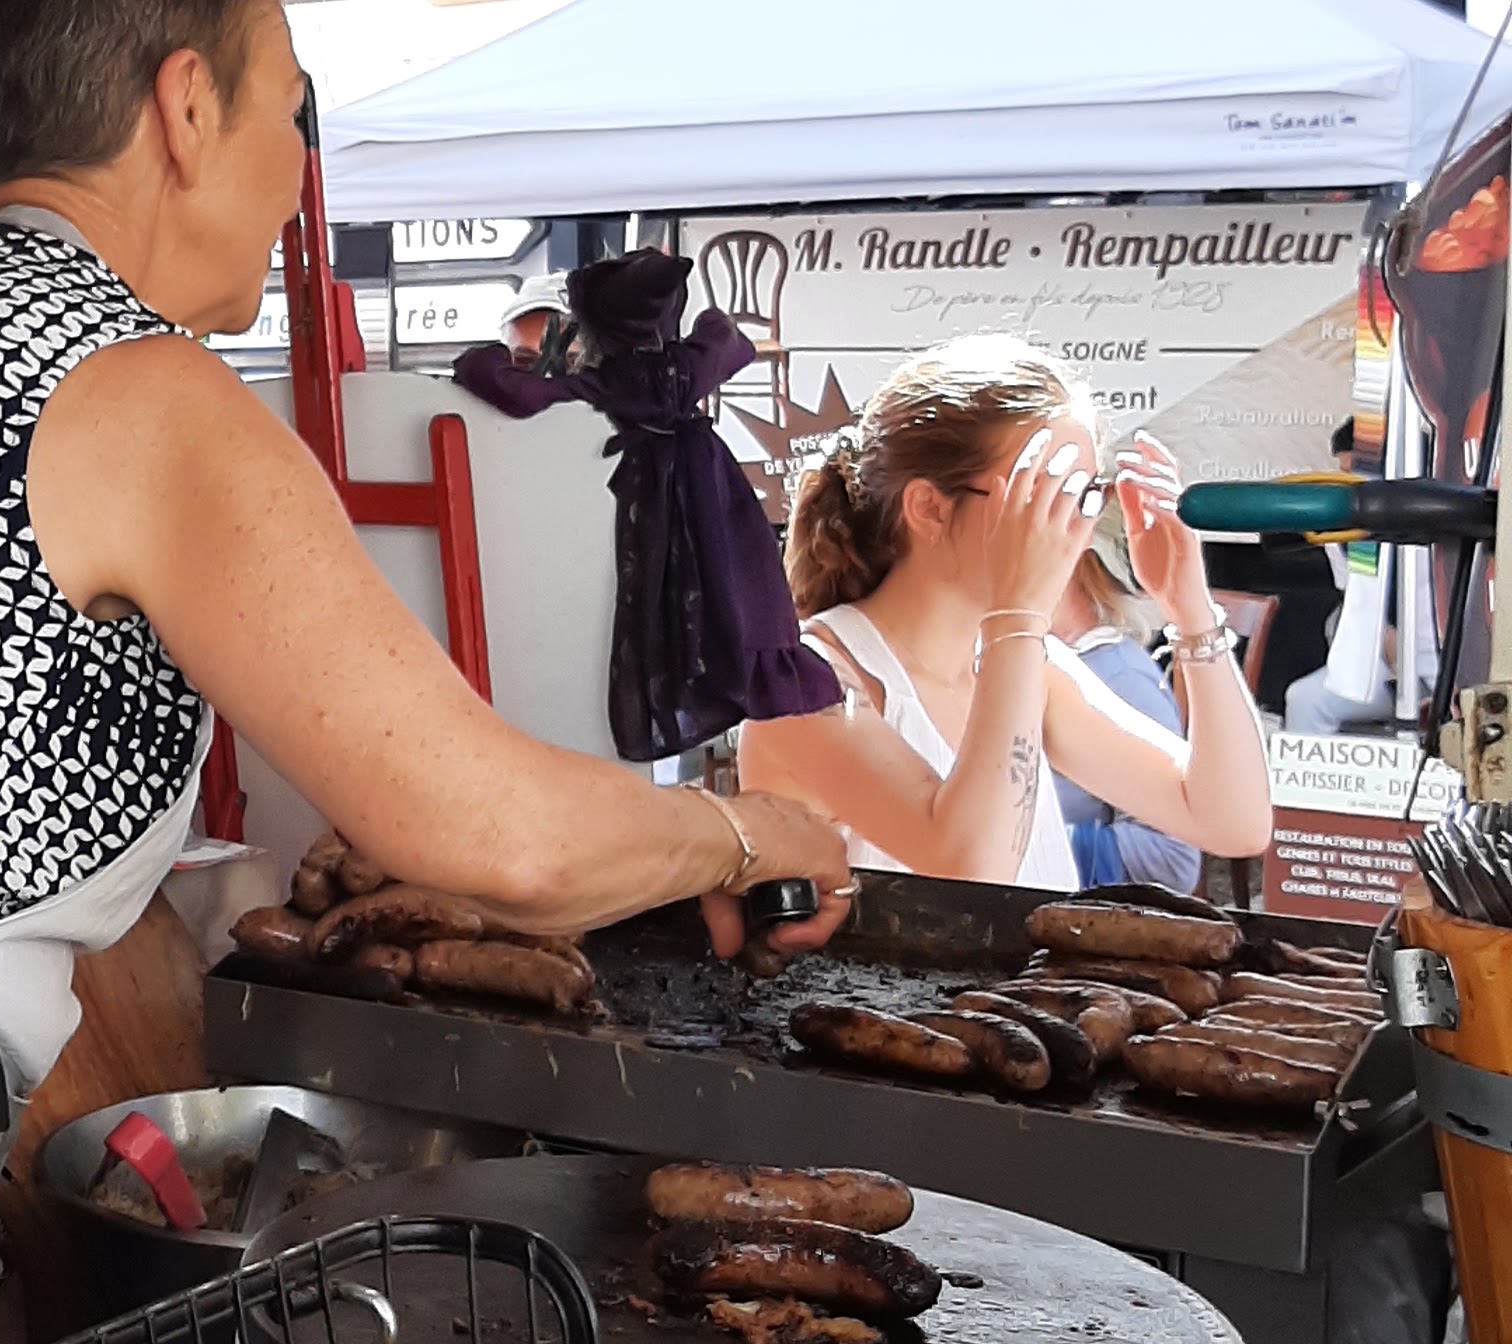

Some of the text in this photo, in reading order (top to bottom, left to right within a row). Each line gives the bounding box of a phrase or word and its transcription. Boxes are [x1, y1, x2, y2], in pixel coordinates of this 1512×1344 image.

[793, 221, 1354, 281] M. Randle Rempailleur
[1061, 338, 1148, 362] SOIGNÉ
[1278, 738, 1400, 769] MAISON
[1273, 767, 1367, 793] TAPISSIER
